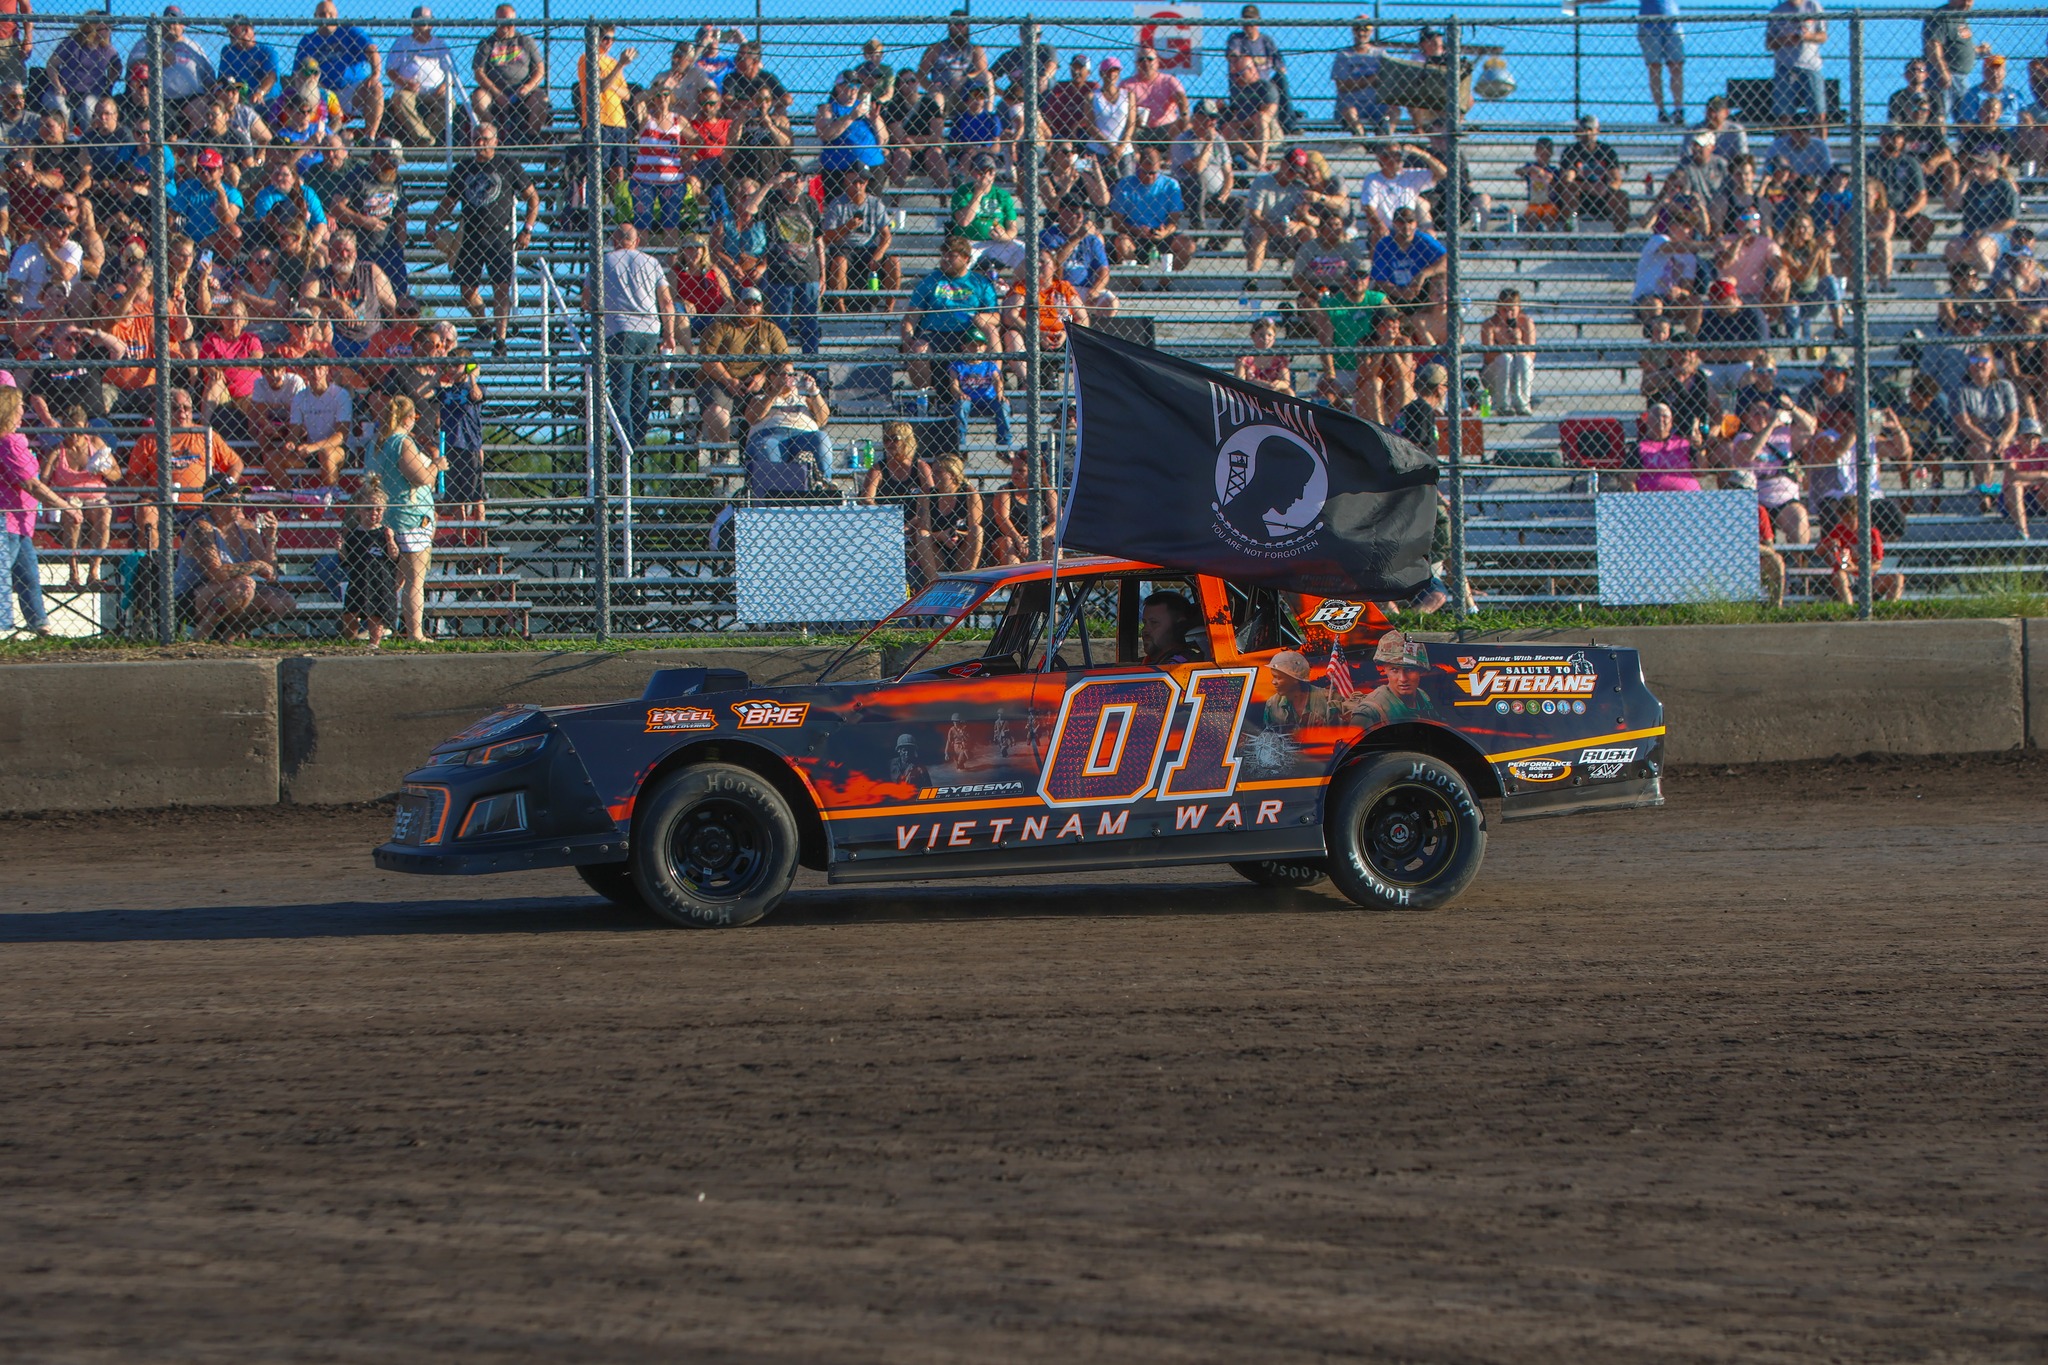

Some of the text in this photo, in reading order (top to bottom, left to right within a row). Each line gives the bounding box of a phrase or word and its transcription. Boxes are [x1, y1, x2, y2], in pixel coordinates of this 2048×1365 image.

[1140, 11, 1191, 69] G
[1208, 381, 1329, 465] POW MIA
[1210, 522, 1319, 559] YOU ARE NOT FORGOTTEN
[1468, 670, 1598, 697] VETERANS
[1505, 666, 1571, 674] SALUTE TO
[651, 711, 711, 723] EXCEL
[743, 707, 804, 725] BHE
[1036, 667, 1258, 809] 01
[1581, 749, 1636, 762] RUSH
[703, 771, 783, 820] Hoosier
[936, 782, 1022, 795] SYBESMA
[1406, 762, 1475, 818] Hoosier
[896, 799, 1284, 850] VIETNAM WAR
[1348, 851, 1410, 905] Hoosier
[655, 880, 735, 925] Hoosier
